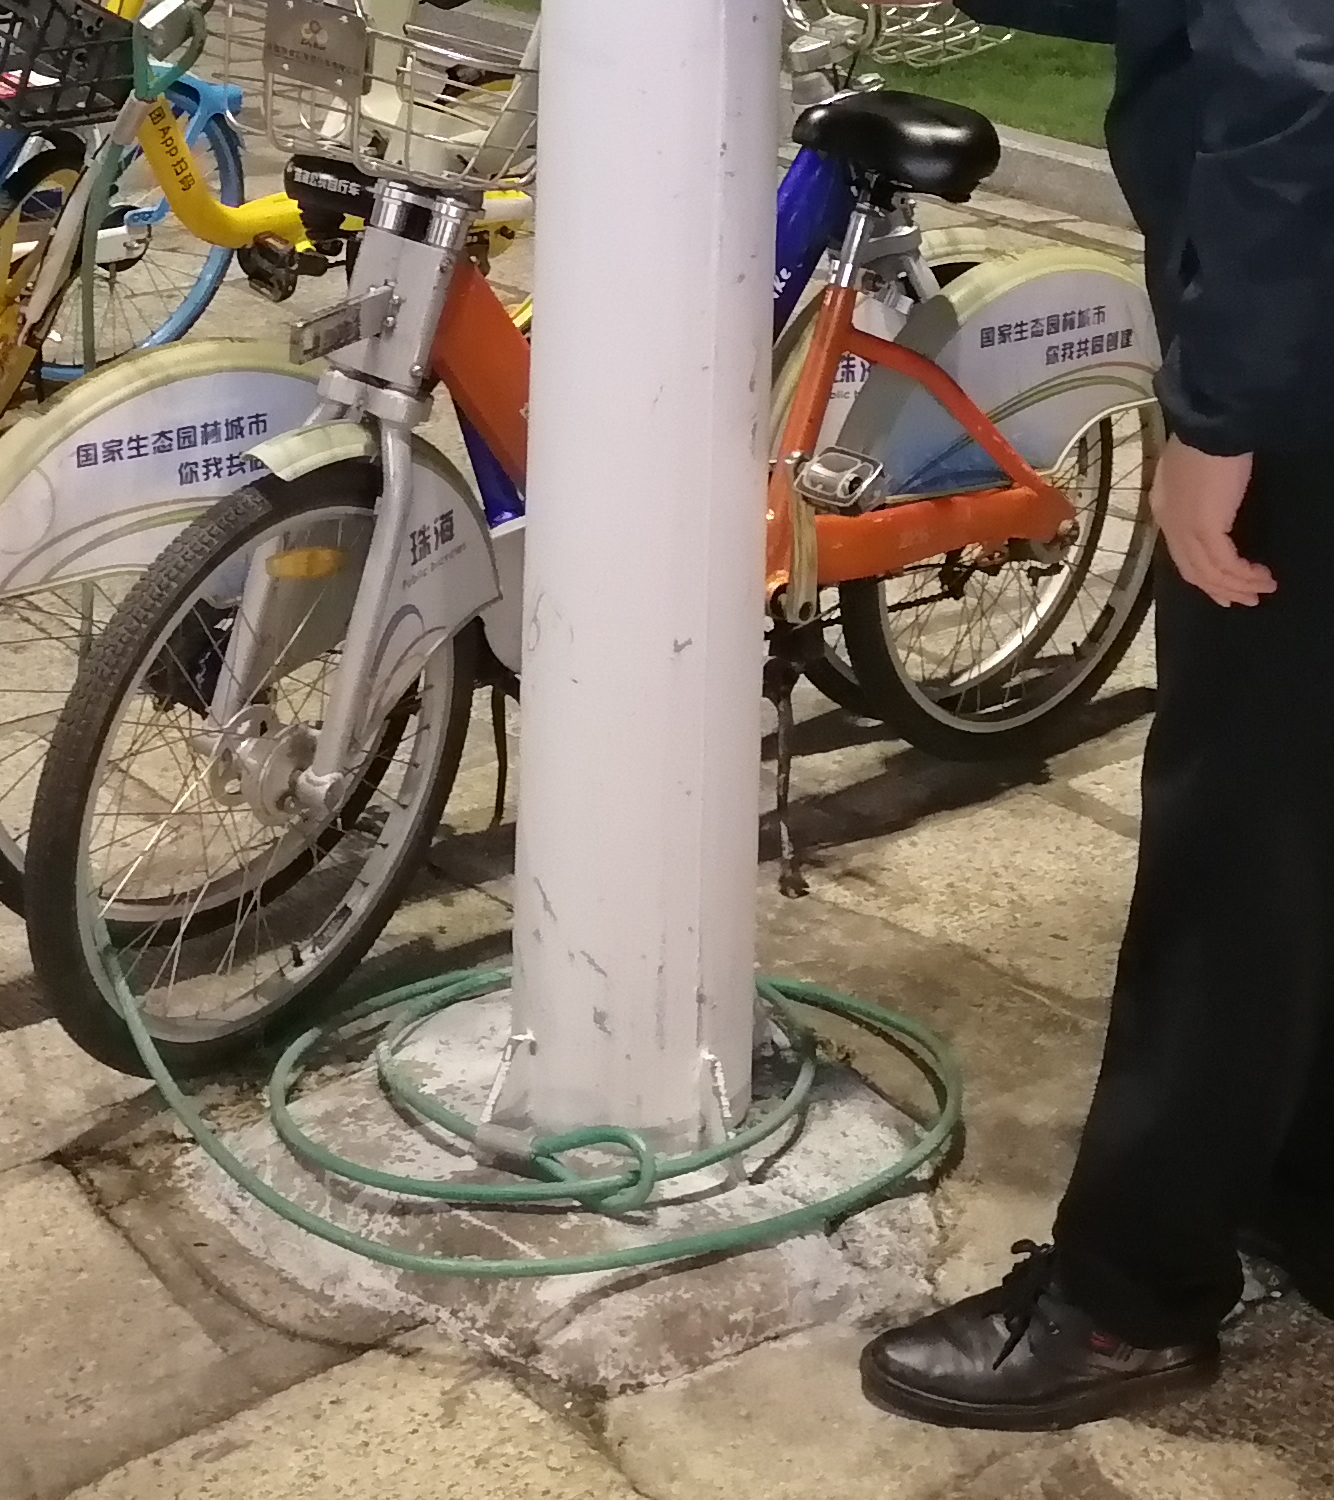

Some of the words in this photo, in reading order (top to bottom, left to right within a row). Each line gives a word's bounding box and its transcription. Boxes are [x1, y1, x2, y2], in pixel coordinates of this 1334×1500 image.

[980, 305, 1106, 348] 国家生态园林城市
[76, 412, 268, 468] 国家生态园林城市
[409, 509, 454, 566] 珠海
